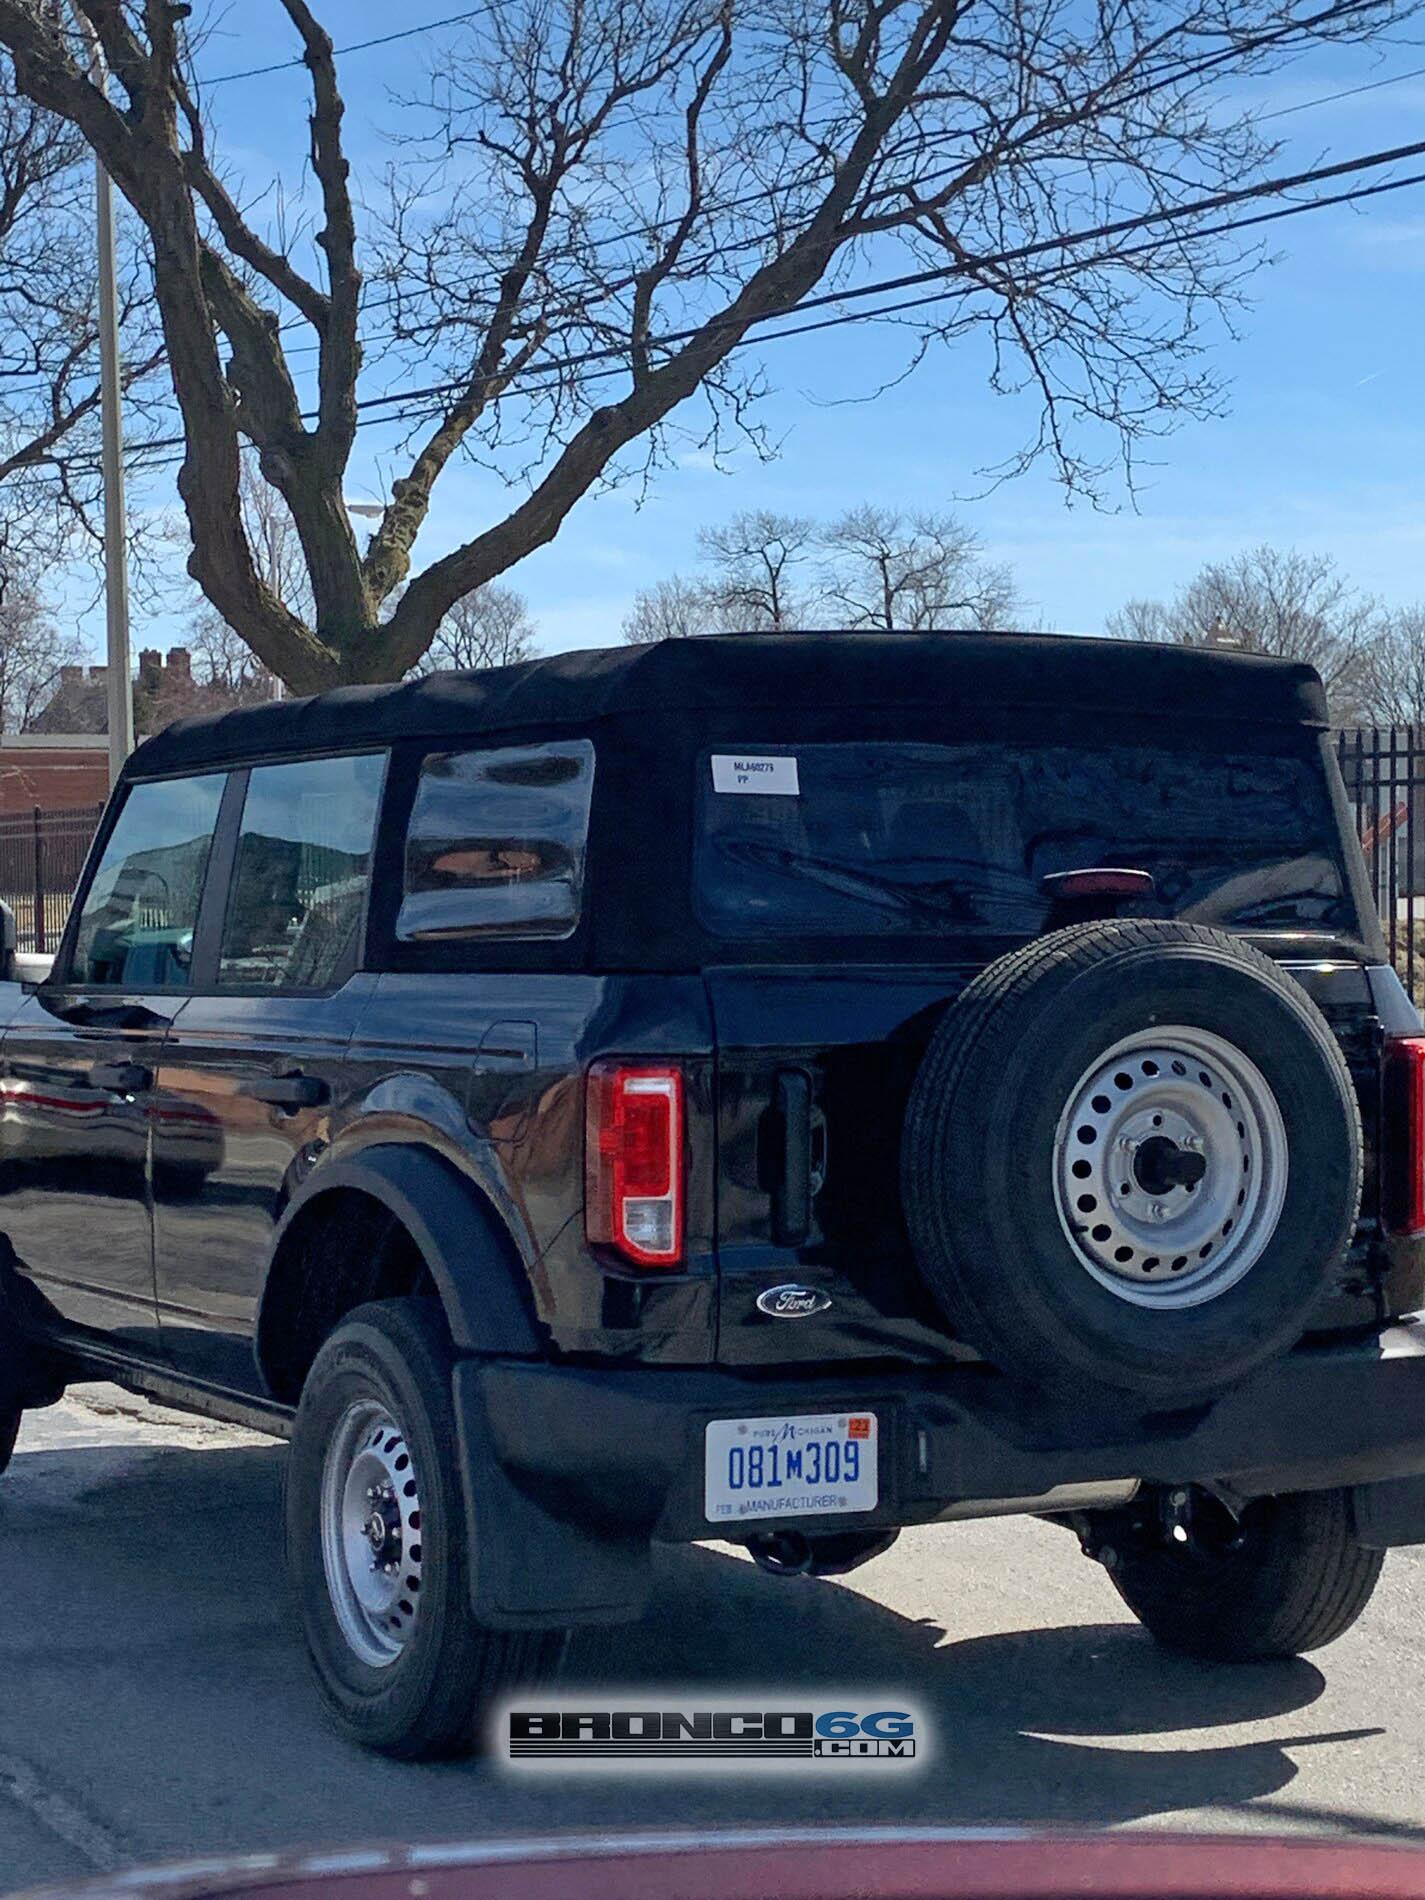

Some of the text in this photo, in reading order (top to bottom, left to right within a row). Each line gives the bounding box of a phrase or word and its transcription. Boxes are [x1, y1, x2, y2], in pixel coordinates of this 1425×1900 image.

[775, 1291, 816, 1310] Ford
[728, 1441, 859, 1489] 081M309
[746, 1495, 836, 1512] MANUFACTURER
